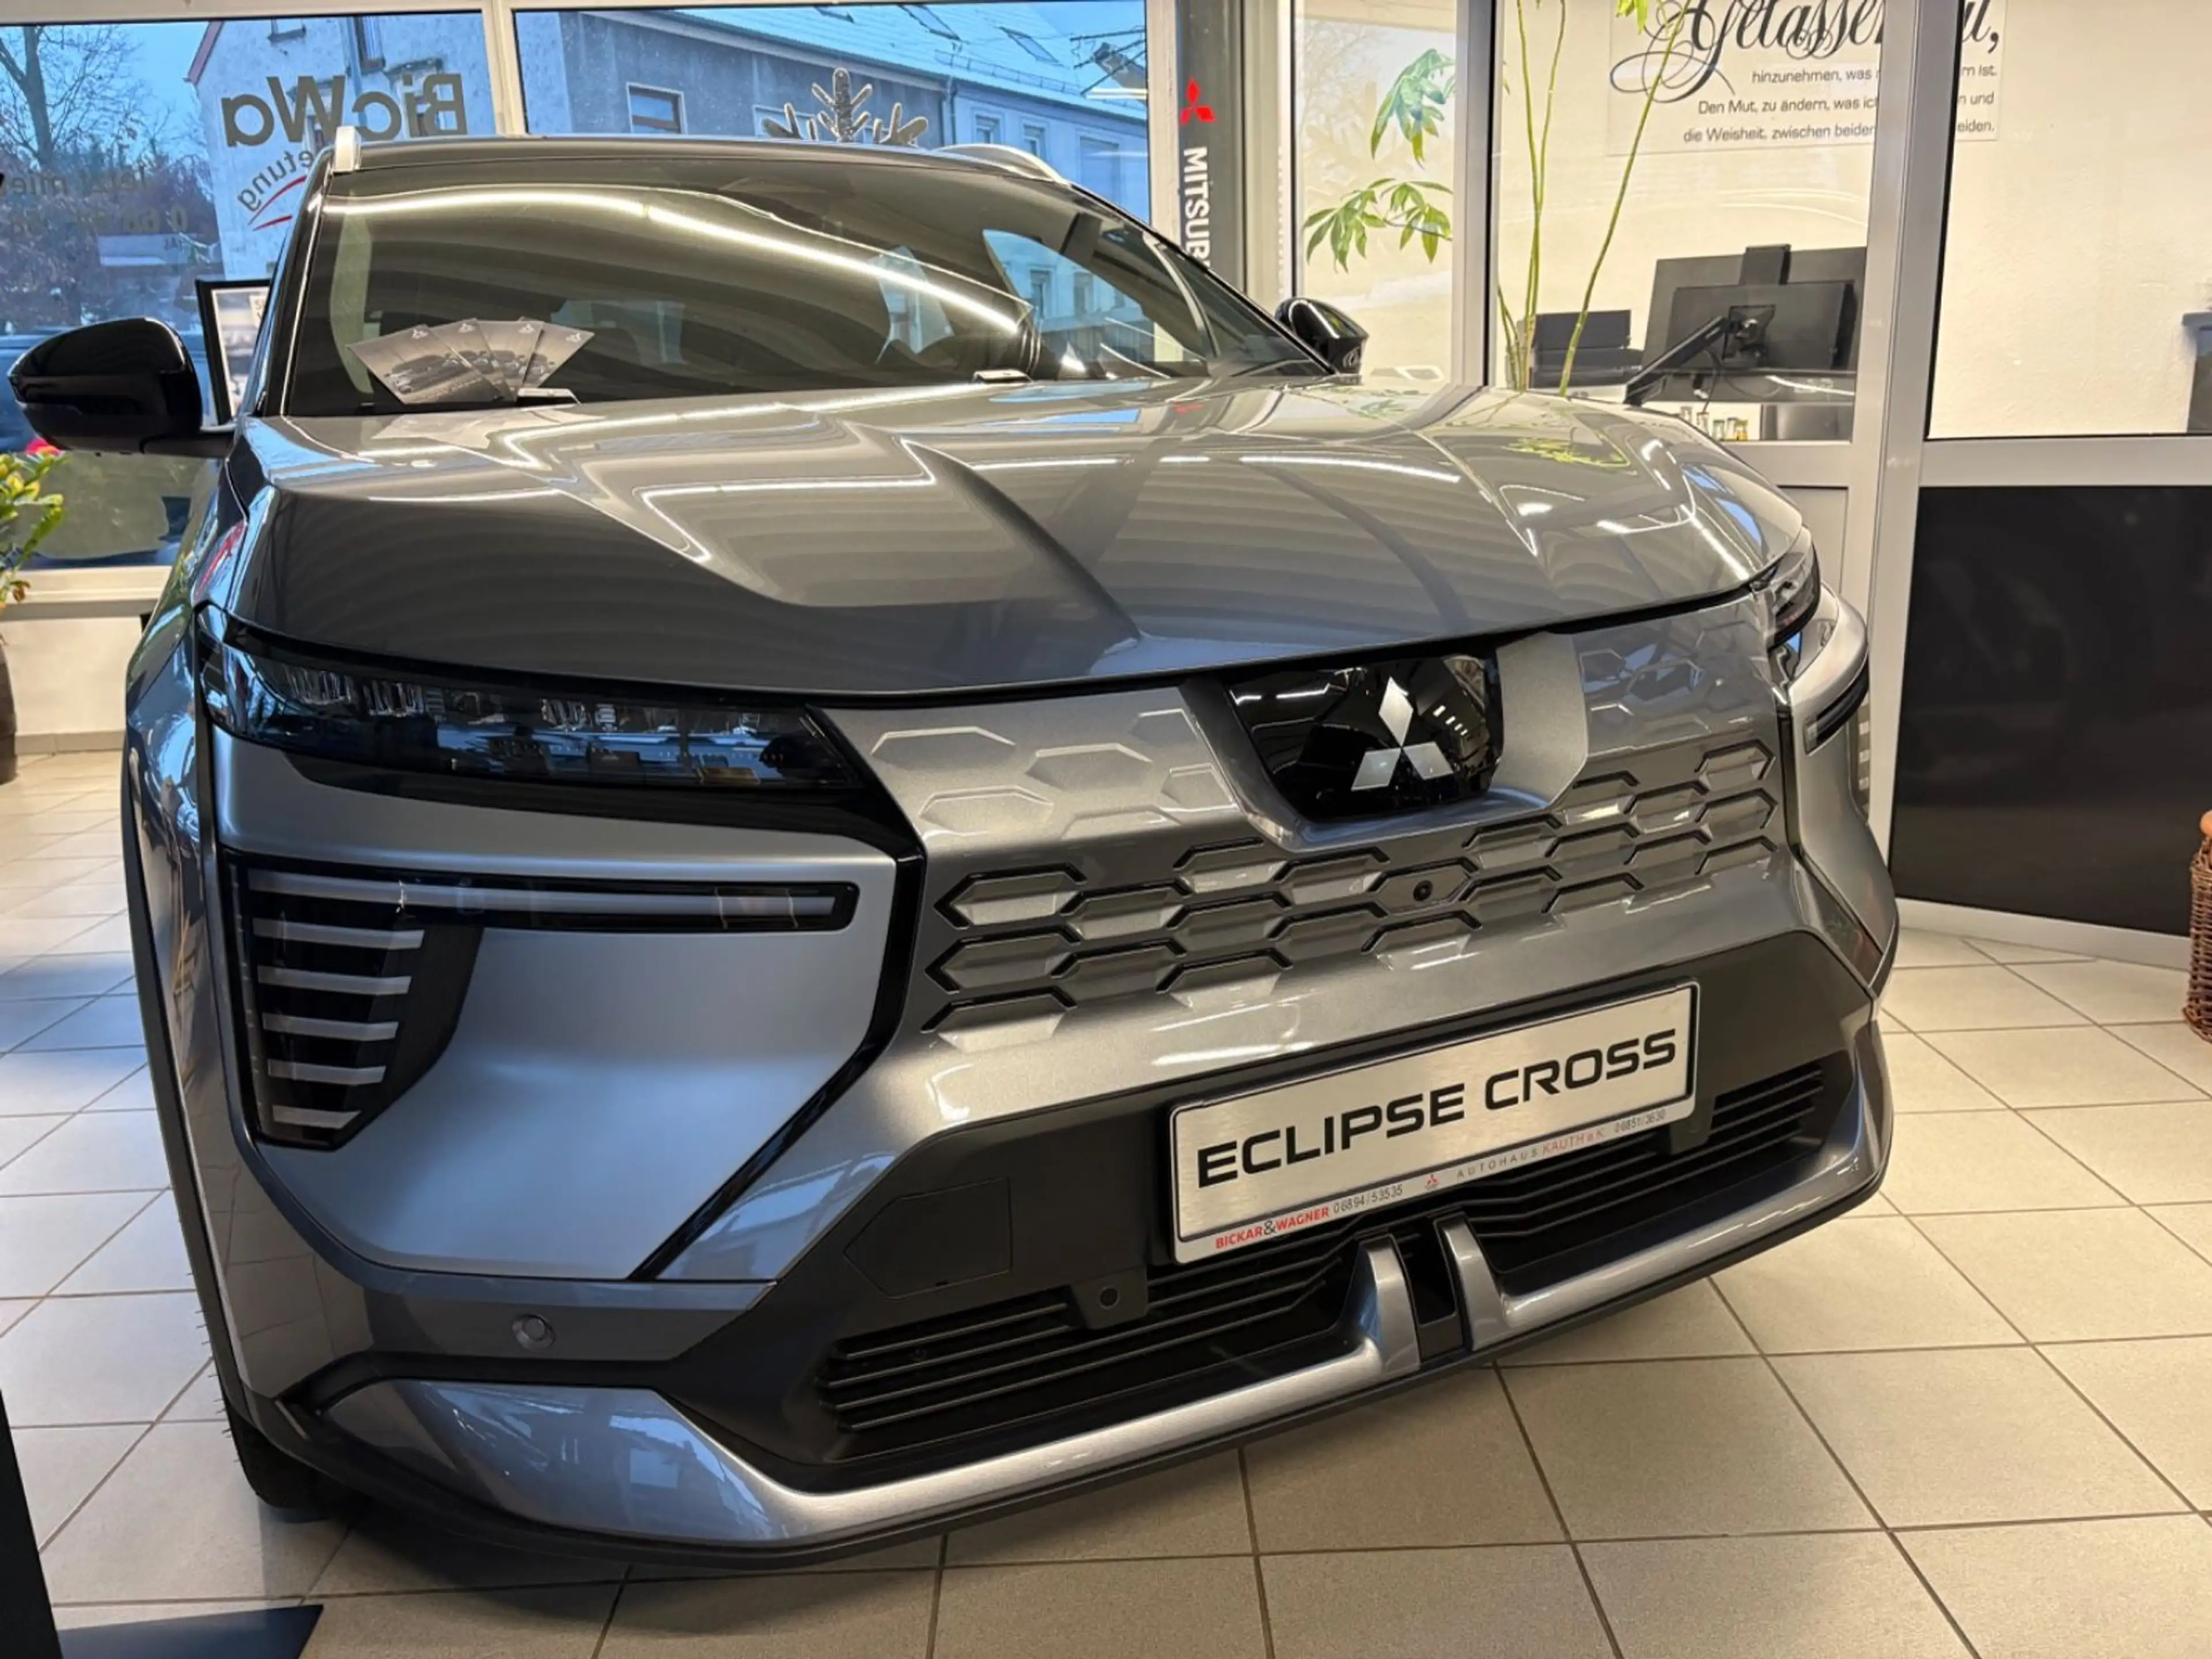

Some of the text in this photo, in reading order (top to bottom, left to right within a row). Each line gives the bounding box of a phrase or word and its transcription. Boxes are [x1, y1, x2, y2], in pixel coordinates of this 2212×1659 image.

[1752, 69, 1842, 84] hinzunehmen,
[1846, 69, 1872, 80] was
[1698, 100, 1725, 115] Den
[1762, 101, 1777, 113] zu
[1834, 98, 1859, 110] was
[1970, 92, 1995, 105] und
[1684, 129, 1703, 143] die
[1772, 125, 1830, 140] zwischen
[1183, 147, 1211, 266] MITSUB
[1198, 1029, 1676, 1188] ECLIPSE CROSS
[1457, 1149, 1538, 1179] AUTOHAUS
